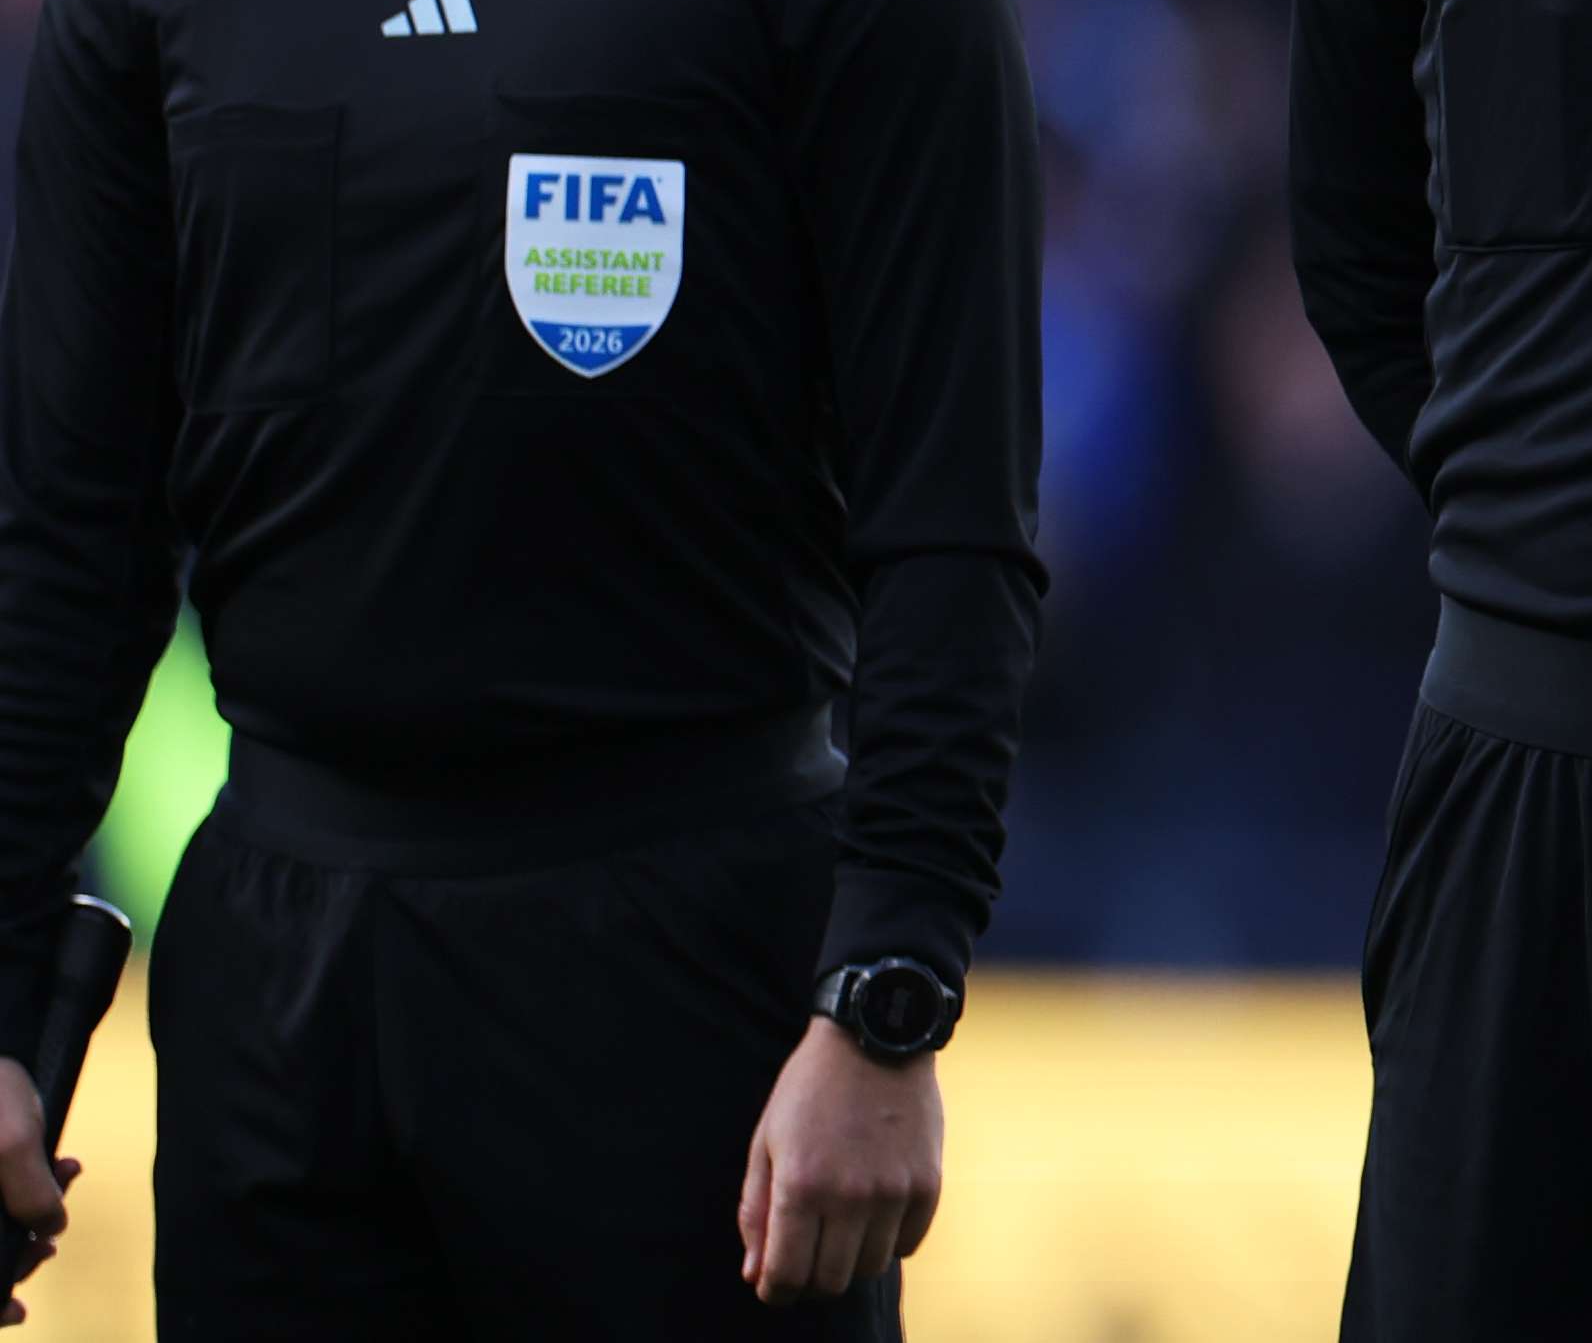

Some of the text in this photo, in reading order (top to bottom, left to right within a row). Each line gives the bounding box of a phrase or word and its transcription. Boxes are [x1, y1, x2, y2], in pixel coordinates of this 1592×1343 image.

[524, 172, 666, 225] FIFA
[523, 247, 666, 271] ASSISTANT
[533, 273, 652, 298] REFEREE
[557, 327, 624, 354] 2026
